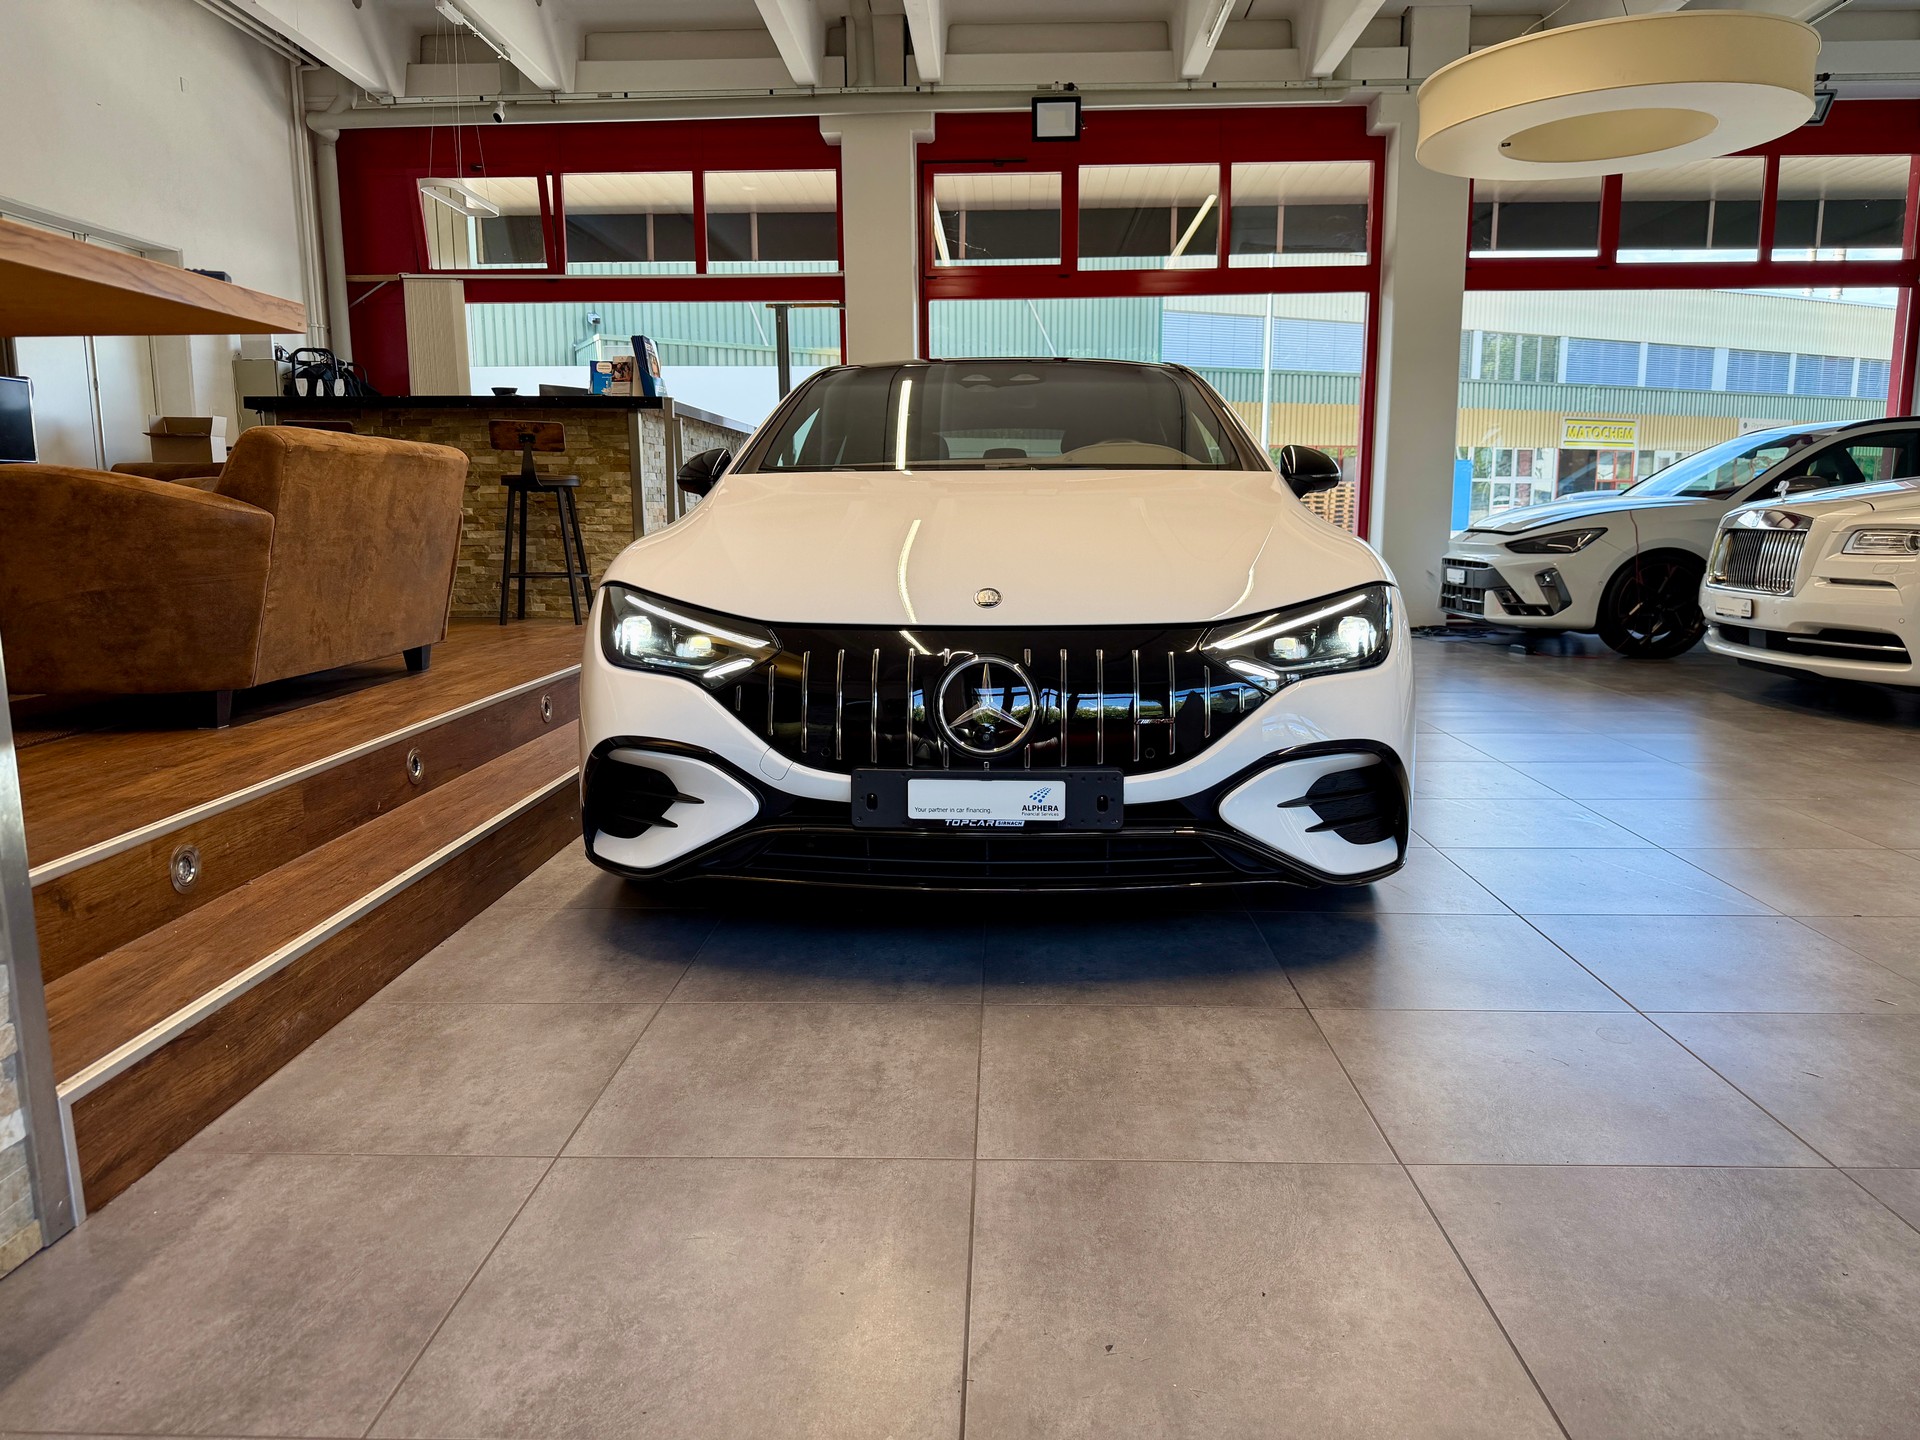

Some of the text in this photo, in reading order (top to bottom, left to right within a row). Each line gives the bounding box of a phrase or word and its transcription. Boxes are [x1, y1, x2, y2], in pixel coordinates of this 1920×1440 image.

[1566, 426, 1634, 440] MATOCHEM
[915, 806, 927, 814] Your
[928, 807, 948, 815] partner
[1022, 804, 1059, 812] ALPHERA
[945, 819, 995, 827] TOPCAR
